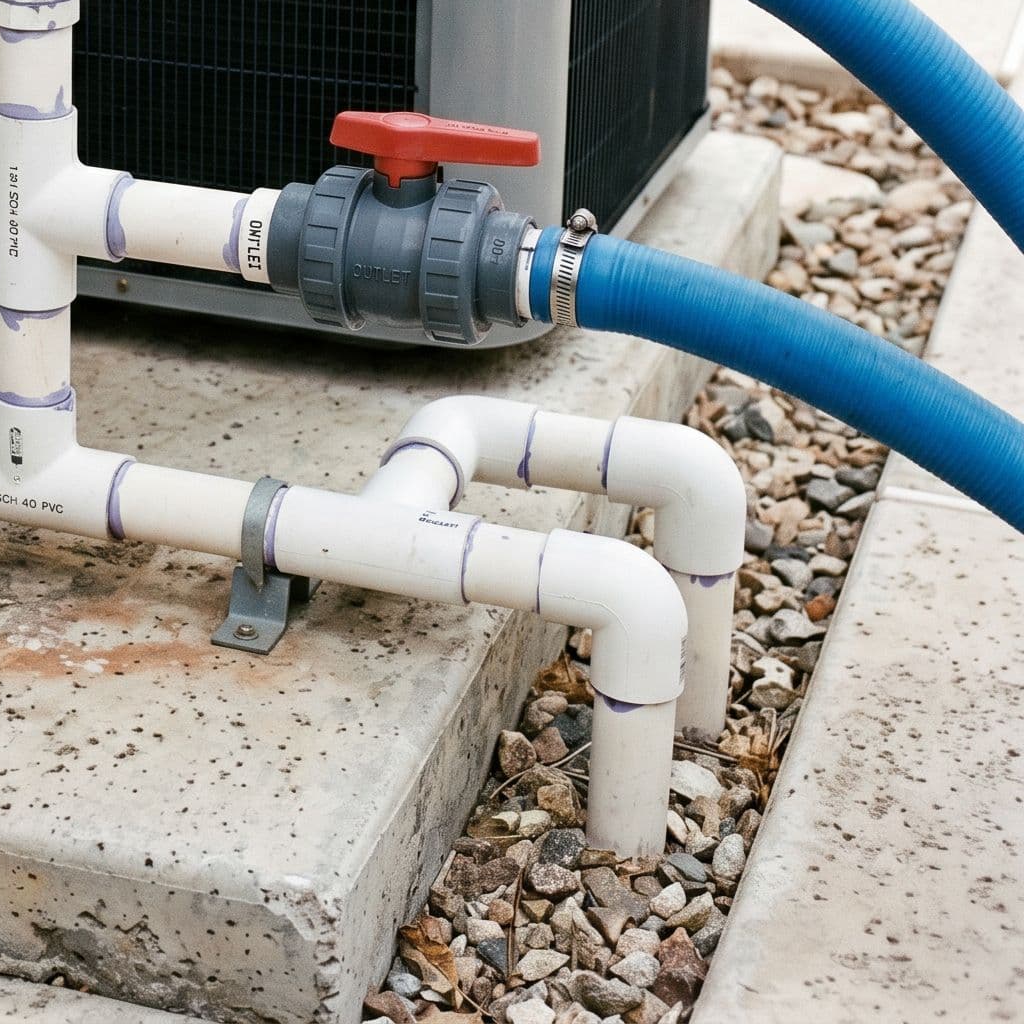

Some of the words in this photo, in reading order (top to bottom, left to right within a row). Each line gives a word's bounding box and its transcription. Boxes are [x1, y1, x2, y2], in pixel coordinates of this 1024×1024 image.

[352, 262, 413, 286] OUTLET
[21, 498, 37, 509] 40
[41, 501, 64, 514] PVC
